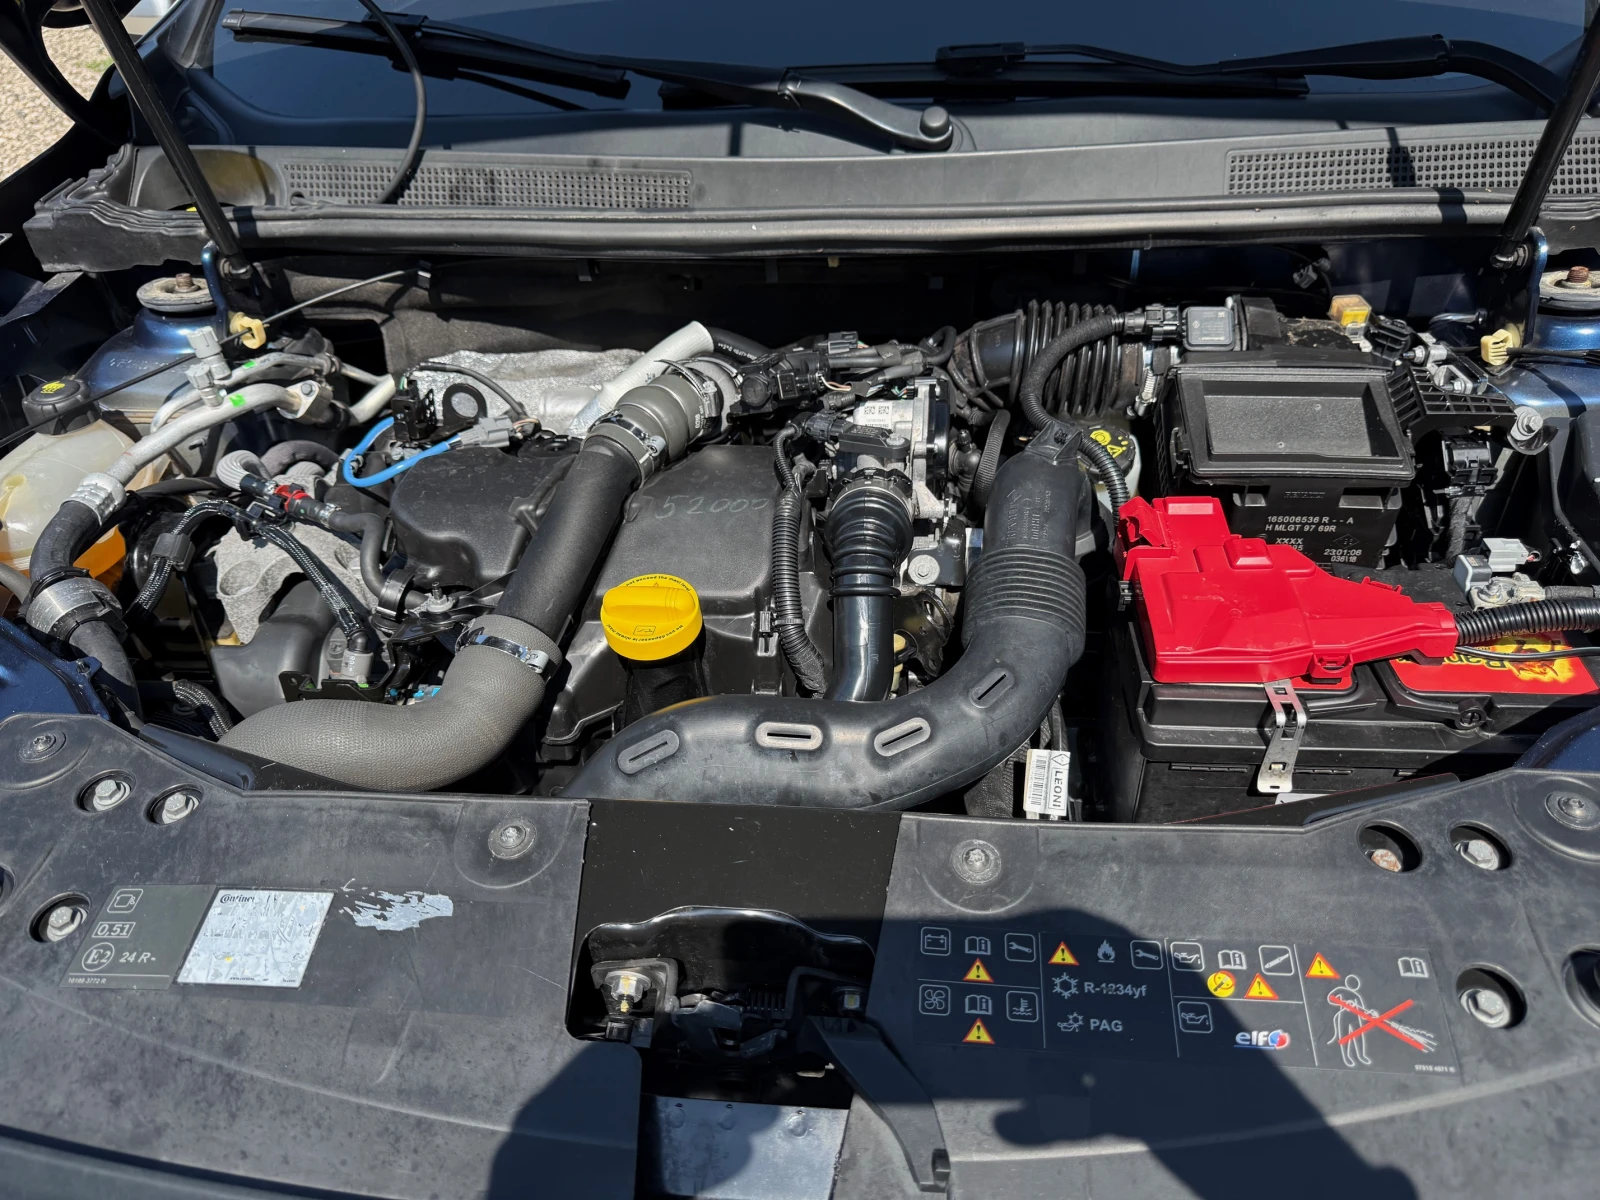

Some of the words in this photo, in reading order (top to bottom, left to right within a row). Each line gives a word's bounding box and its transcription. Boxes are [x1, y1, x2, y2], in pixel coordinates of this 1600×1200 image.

[1267, 515, 1320, 524] 165006536
[1321, 516, 1330, 524] R
[1052, 770, 1064, 808] LEONI
[97, 923, 130, 937] 0,51
[85, 949, 112, 965] E2
[119, 951, 137, 963] 24
[1084, 981, 1147, 999] R-1234yf
[1089, 1018, 1123, 1032] PAG
[1235, 1030, 1270, 1046] elf
